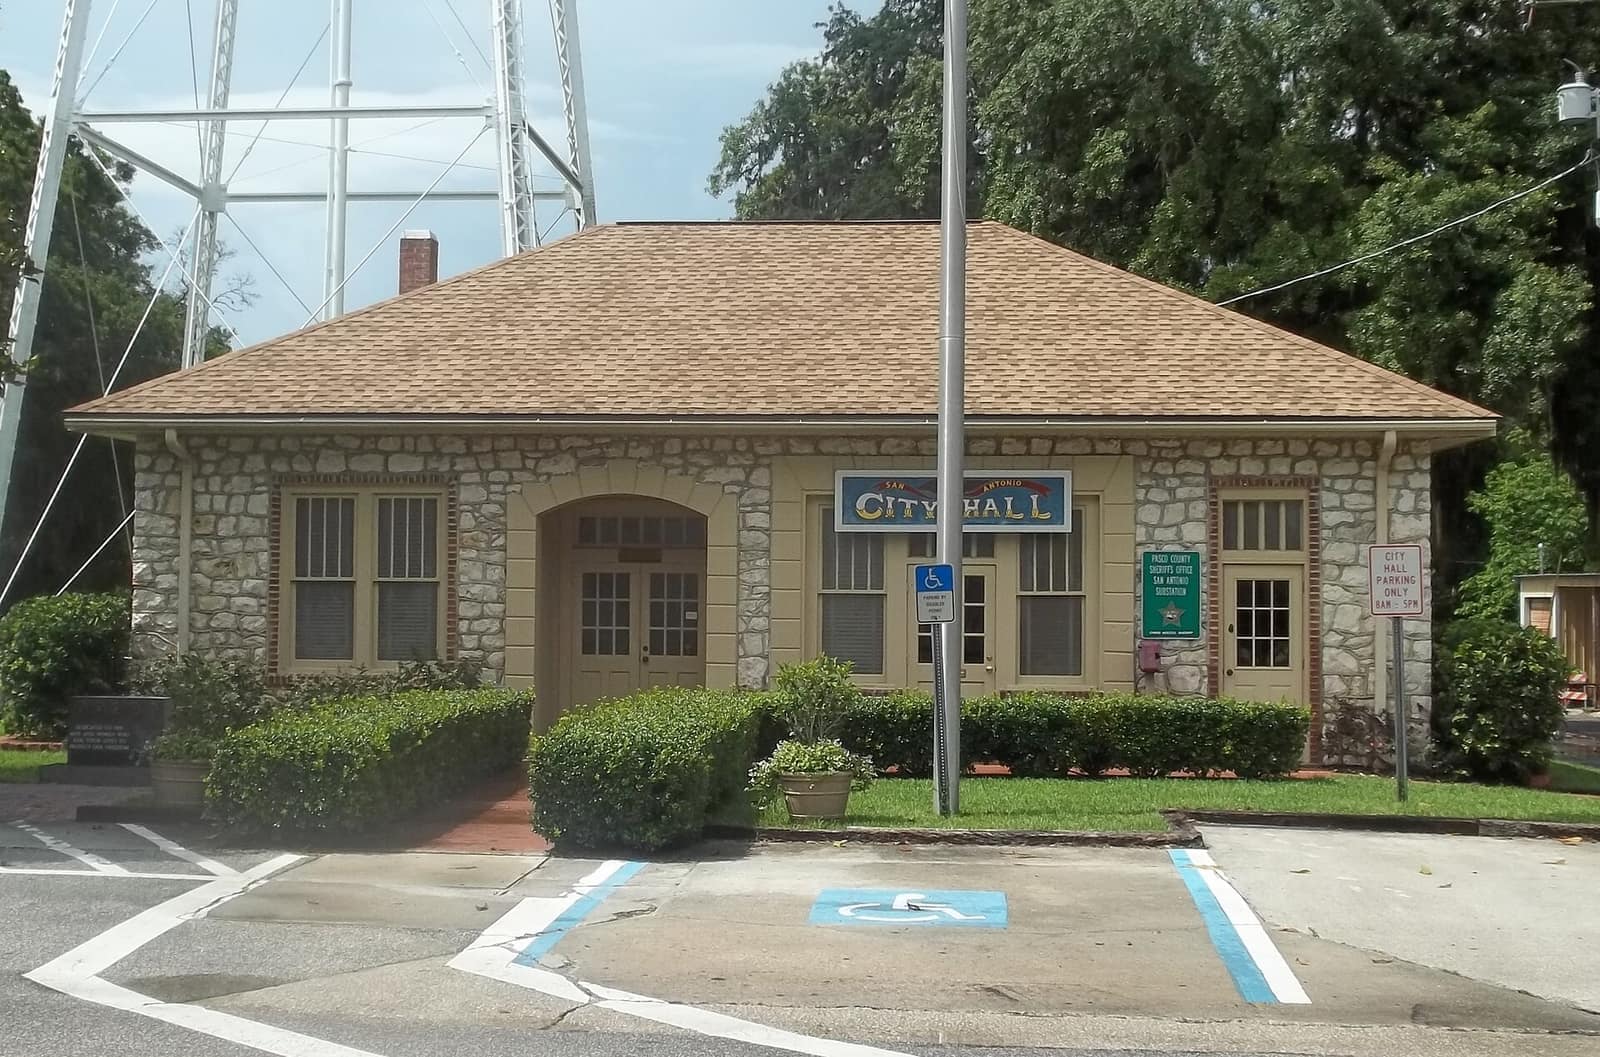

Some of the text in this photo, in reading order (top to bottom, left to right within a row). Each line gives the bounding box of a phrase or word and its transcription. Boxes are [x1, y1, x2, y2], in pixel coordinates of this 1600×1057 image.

[885, 479, 1023, 493] SAN ANTONIO
[855, 492, 1052, 520] CITY HALL
[1151, 554, 1191, 563] PASCO COUNTY
[1385, 551, 1405, 561] CITY
[1175, 565, 1193, 574] OFFICE
[1384, 564, 1408, 573] HALL
[1153, 576, 1190, 585] SAN ANTONIO
[1376, 575, 1416, 585] PARKING
[1155, 587, 1186, 596] SUBSTATION
[1384, 588, 1409, 597] ONLY
[1375, 600, 1392, 609] 8AM
[1403, 600, 1419, 609] 5PM
